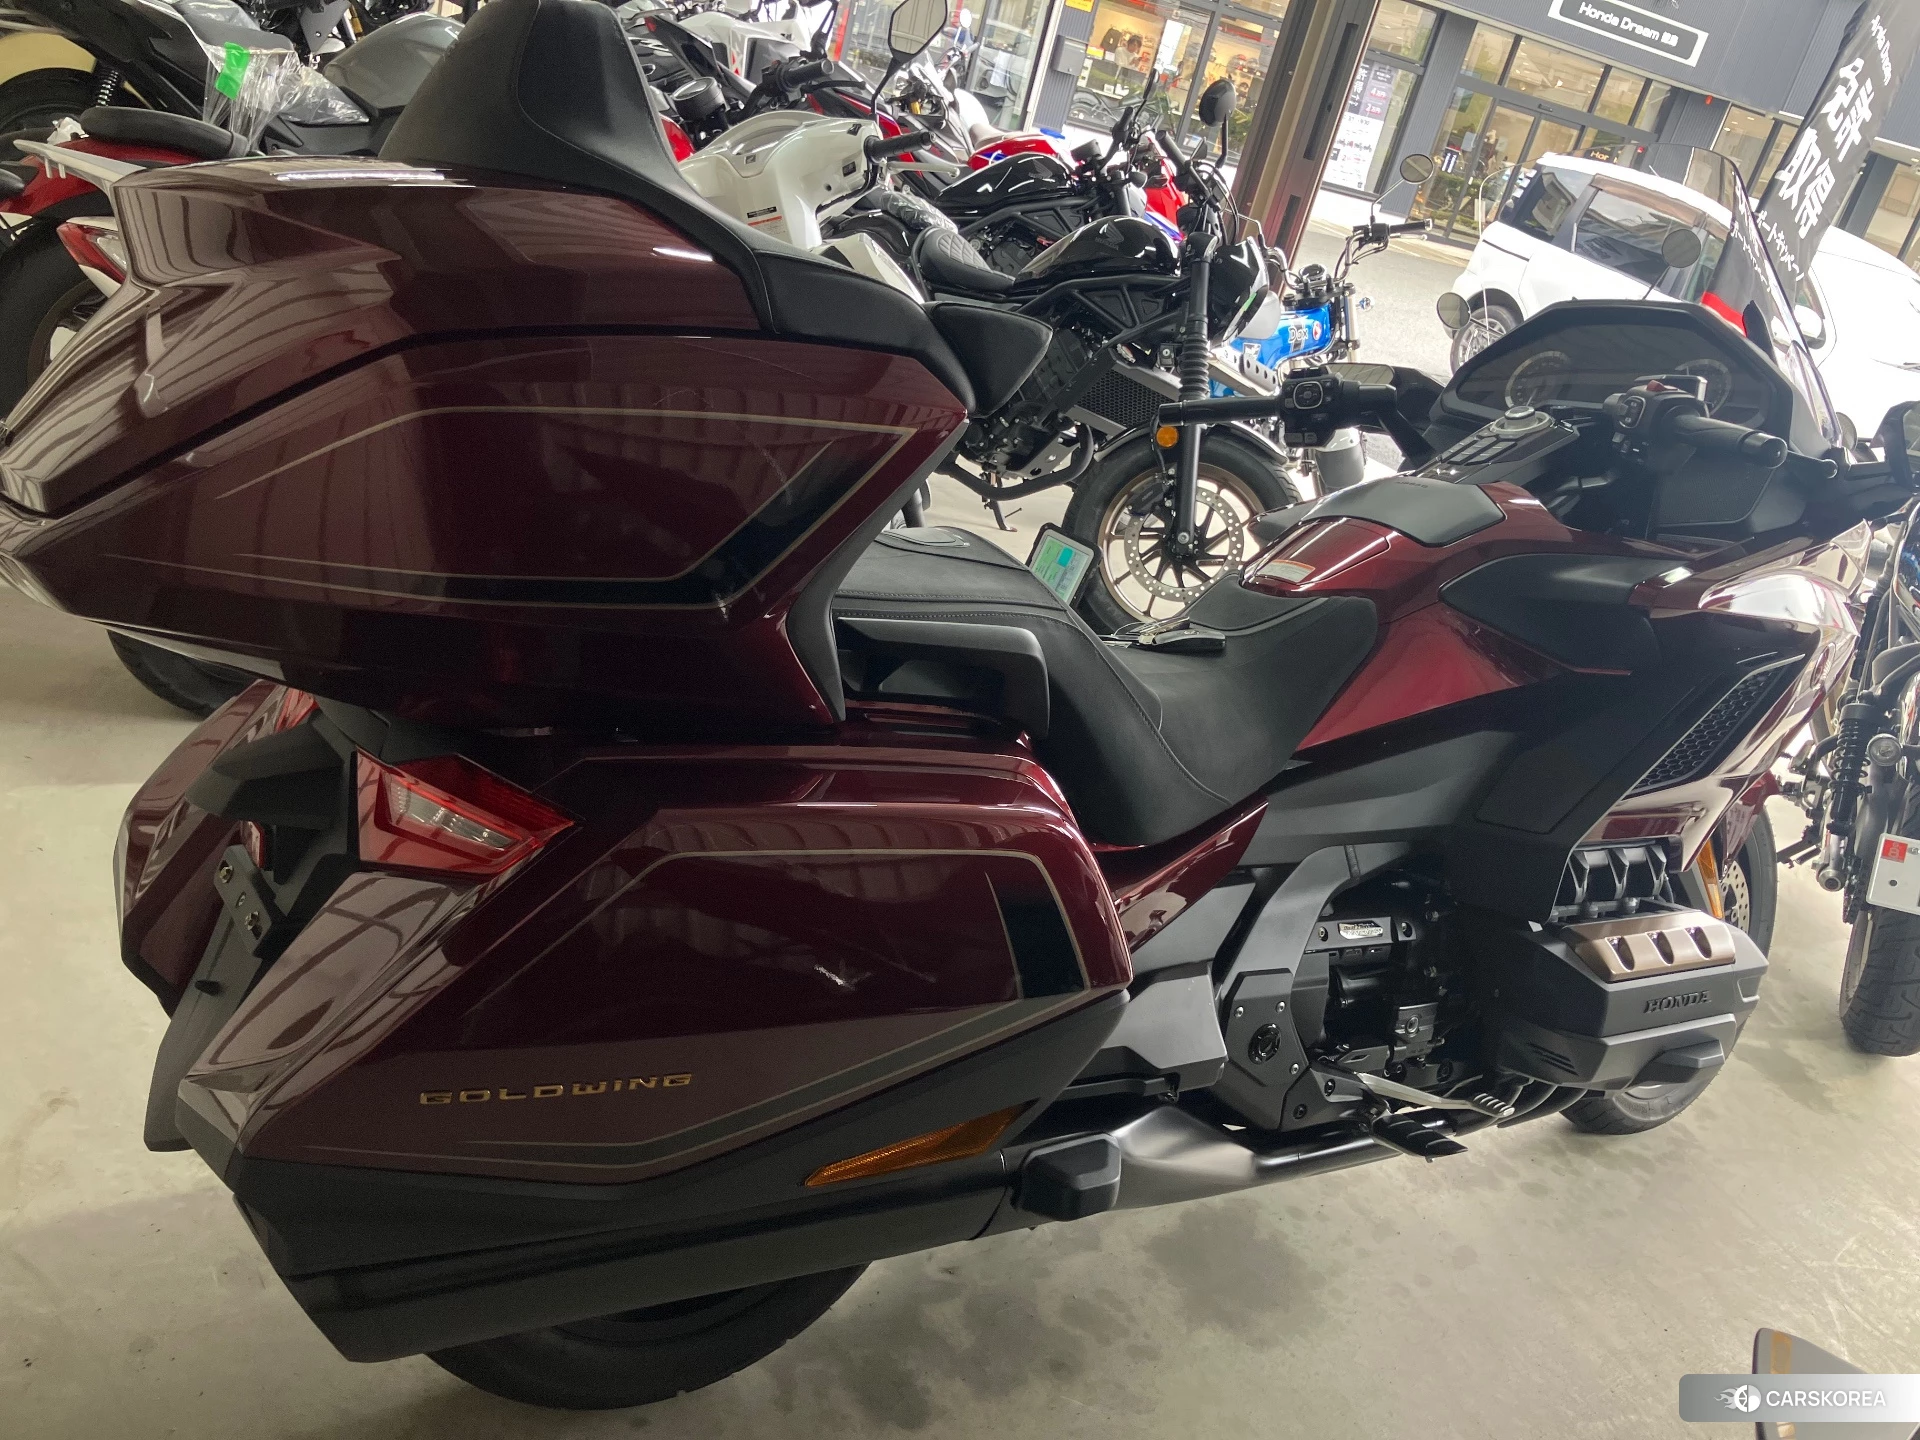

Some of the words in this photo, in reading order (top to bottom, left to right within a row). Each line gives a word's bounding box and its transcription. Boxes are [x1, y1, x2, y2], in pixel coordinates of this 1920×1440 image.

[1578, 1, 1620, 27] Honda
[1620, 16, 1660, 41] Dream
[1820, 57, 1875, 163] 免許
[1775, 126, 1836, 240] 取得
[1643, 990, 1712, 1014] HONDA
[419, 1073, 693, 1105] GOLDWING
